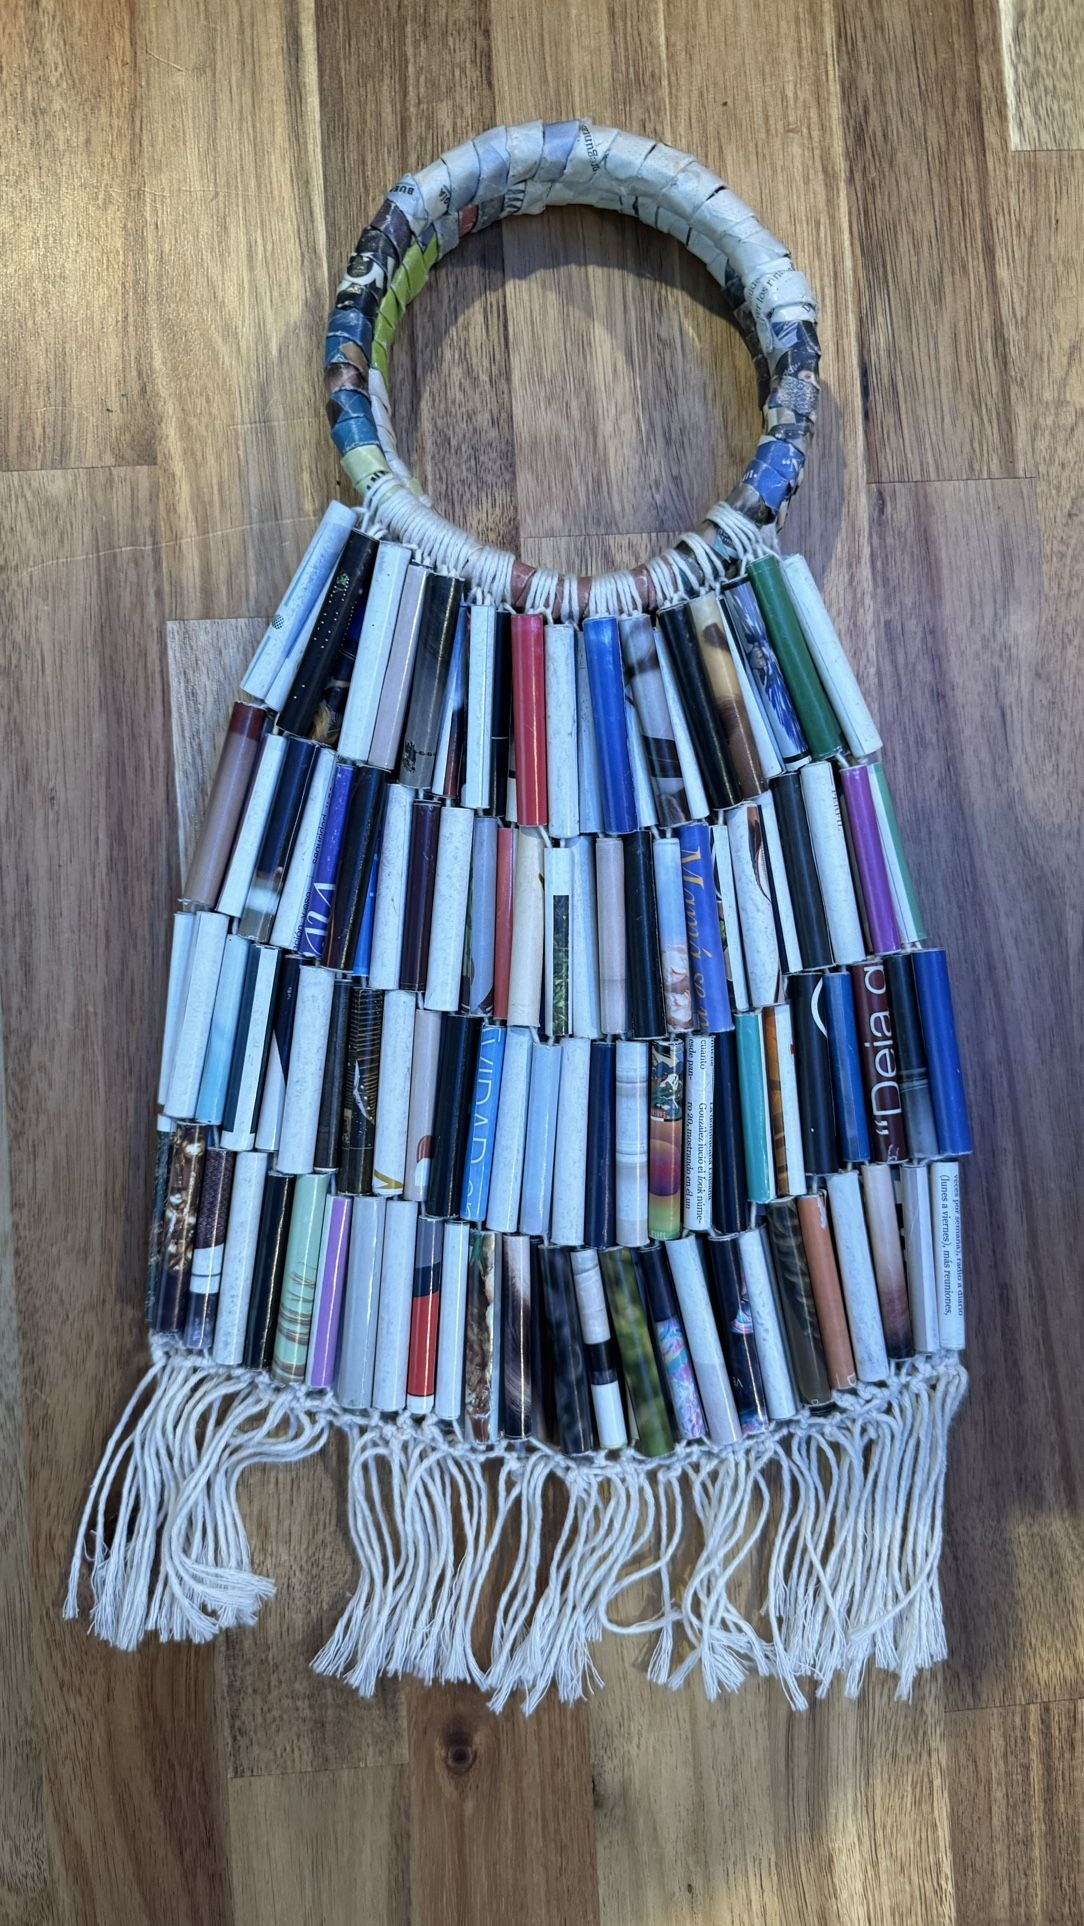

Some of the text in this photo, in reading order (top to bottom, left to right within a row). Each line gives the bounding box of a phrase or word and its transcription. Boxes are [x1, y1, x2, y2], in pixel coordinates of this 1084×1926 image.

[699, 1039, 707, 1070] cuanto
[697, 1102, 708, 1143] González
[685, 1128, 694, 1174] mostrando
[697, 1143, 707, 1165] lució
[696, 1175, 706, 1195] look
[940, 1173, 951, 1202] (lunes
[695, 1195, 706, 1225] núme-
[941, 1210, 952, 1248] viernes),
[943, 1250, 953, 1268] más
[943, 1270, 954, 1316] reuniones,
